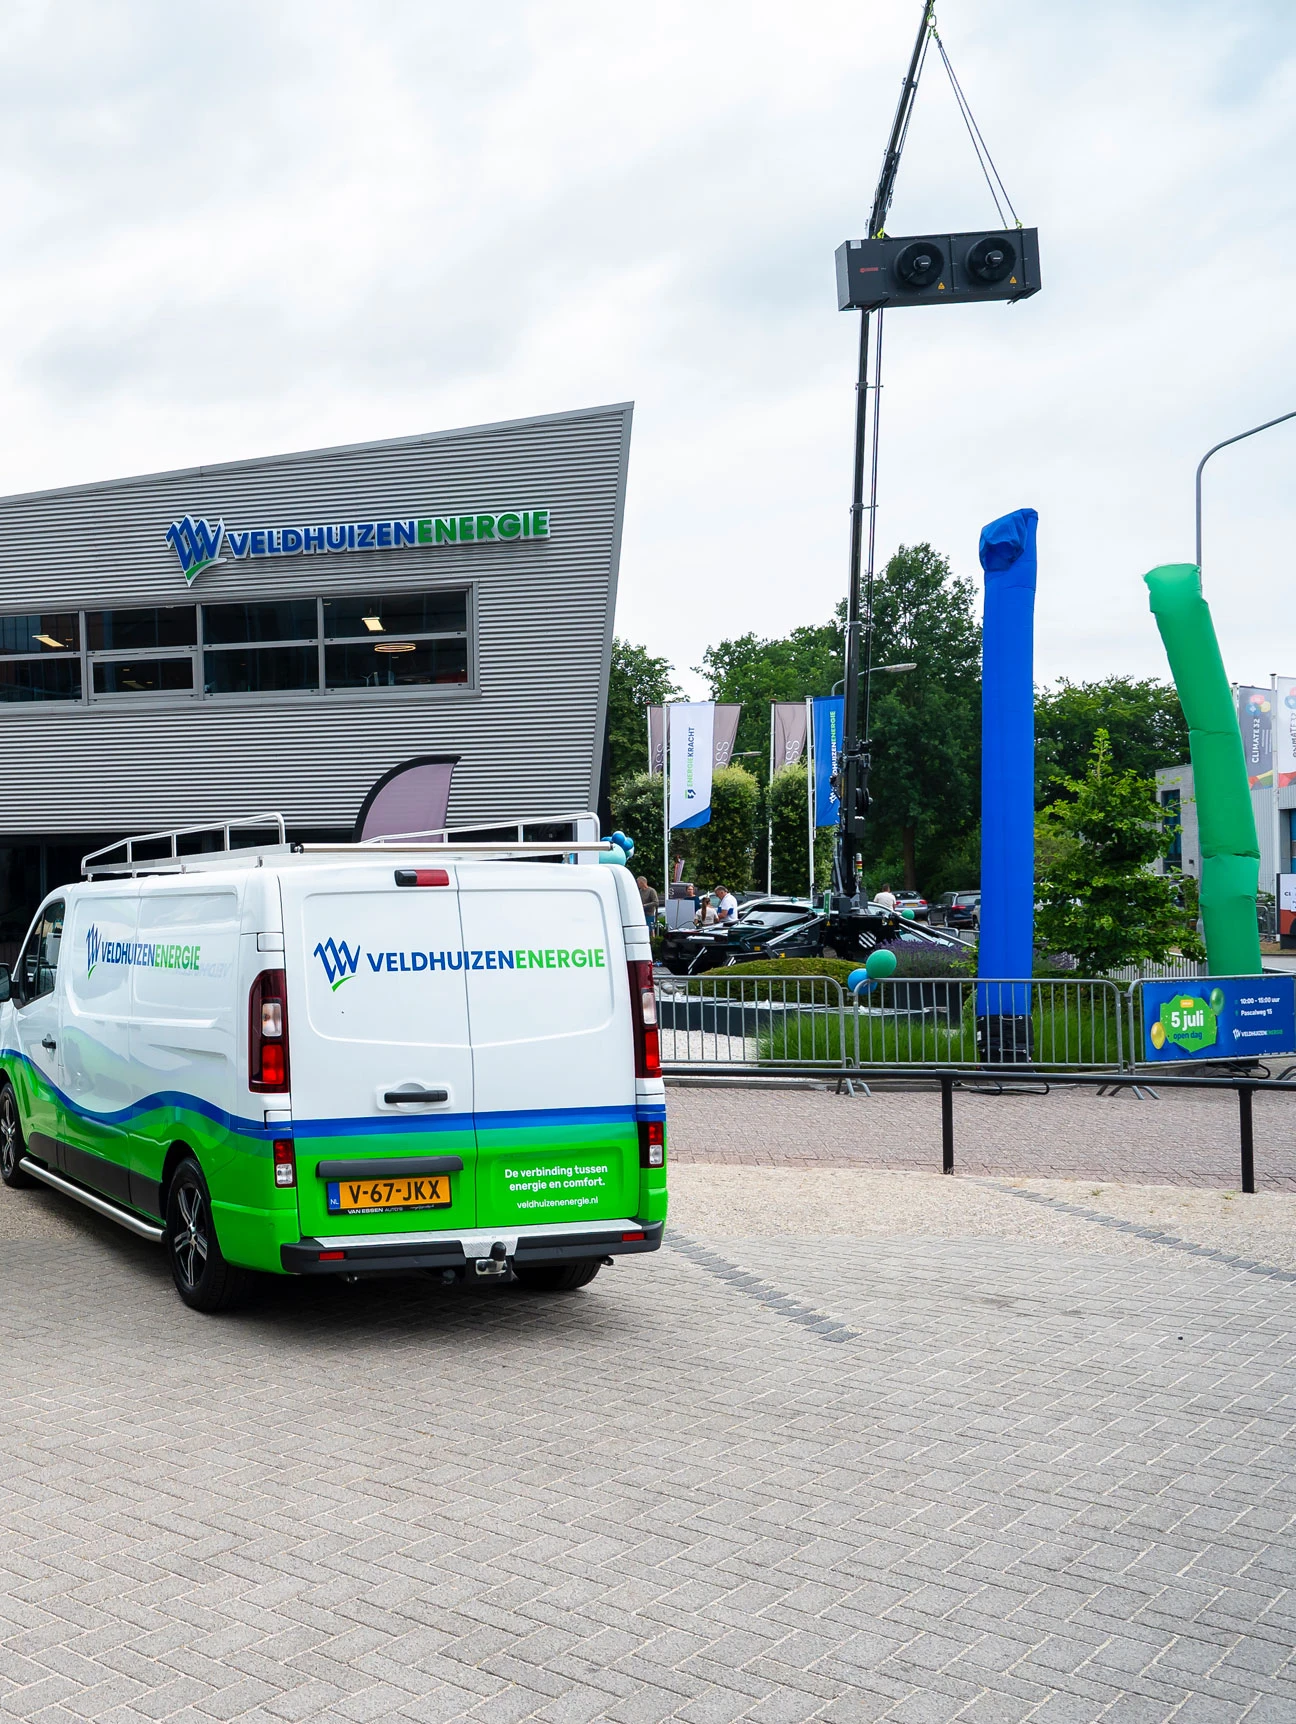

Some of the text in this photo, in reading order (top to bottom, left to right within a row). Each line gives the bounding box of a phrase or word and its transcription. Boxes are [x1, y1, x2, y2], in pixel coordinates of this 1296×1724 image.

[227, 509, 550, 558] VELDHUIZENENERGIE
[687, 727, 695, 787] ENERGIEKRACHT
[1252, 729, 1260, 763] CLIMATE
[101, 941, 201, 971] VELDHUIZENENERGIE
[367, 948, 605, 972] VELDHUIZENENERGIE
[1171, 1010, 1204, 1031] 5 juli
[1173, 1031, 1203, 1041] open dag
[505, 1165, 608, 1178] De verbinding tussen
[349, 1180, 441, 1204] V-67-JKX
[509, 1177, 605, 1192] energie en comfort.
[517, 1196, 598, 1209] veldhuizenenergie.nl
